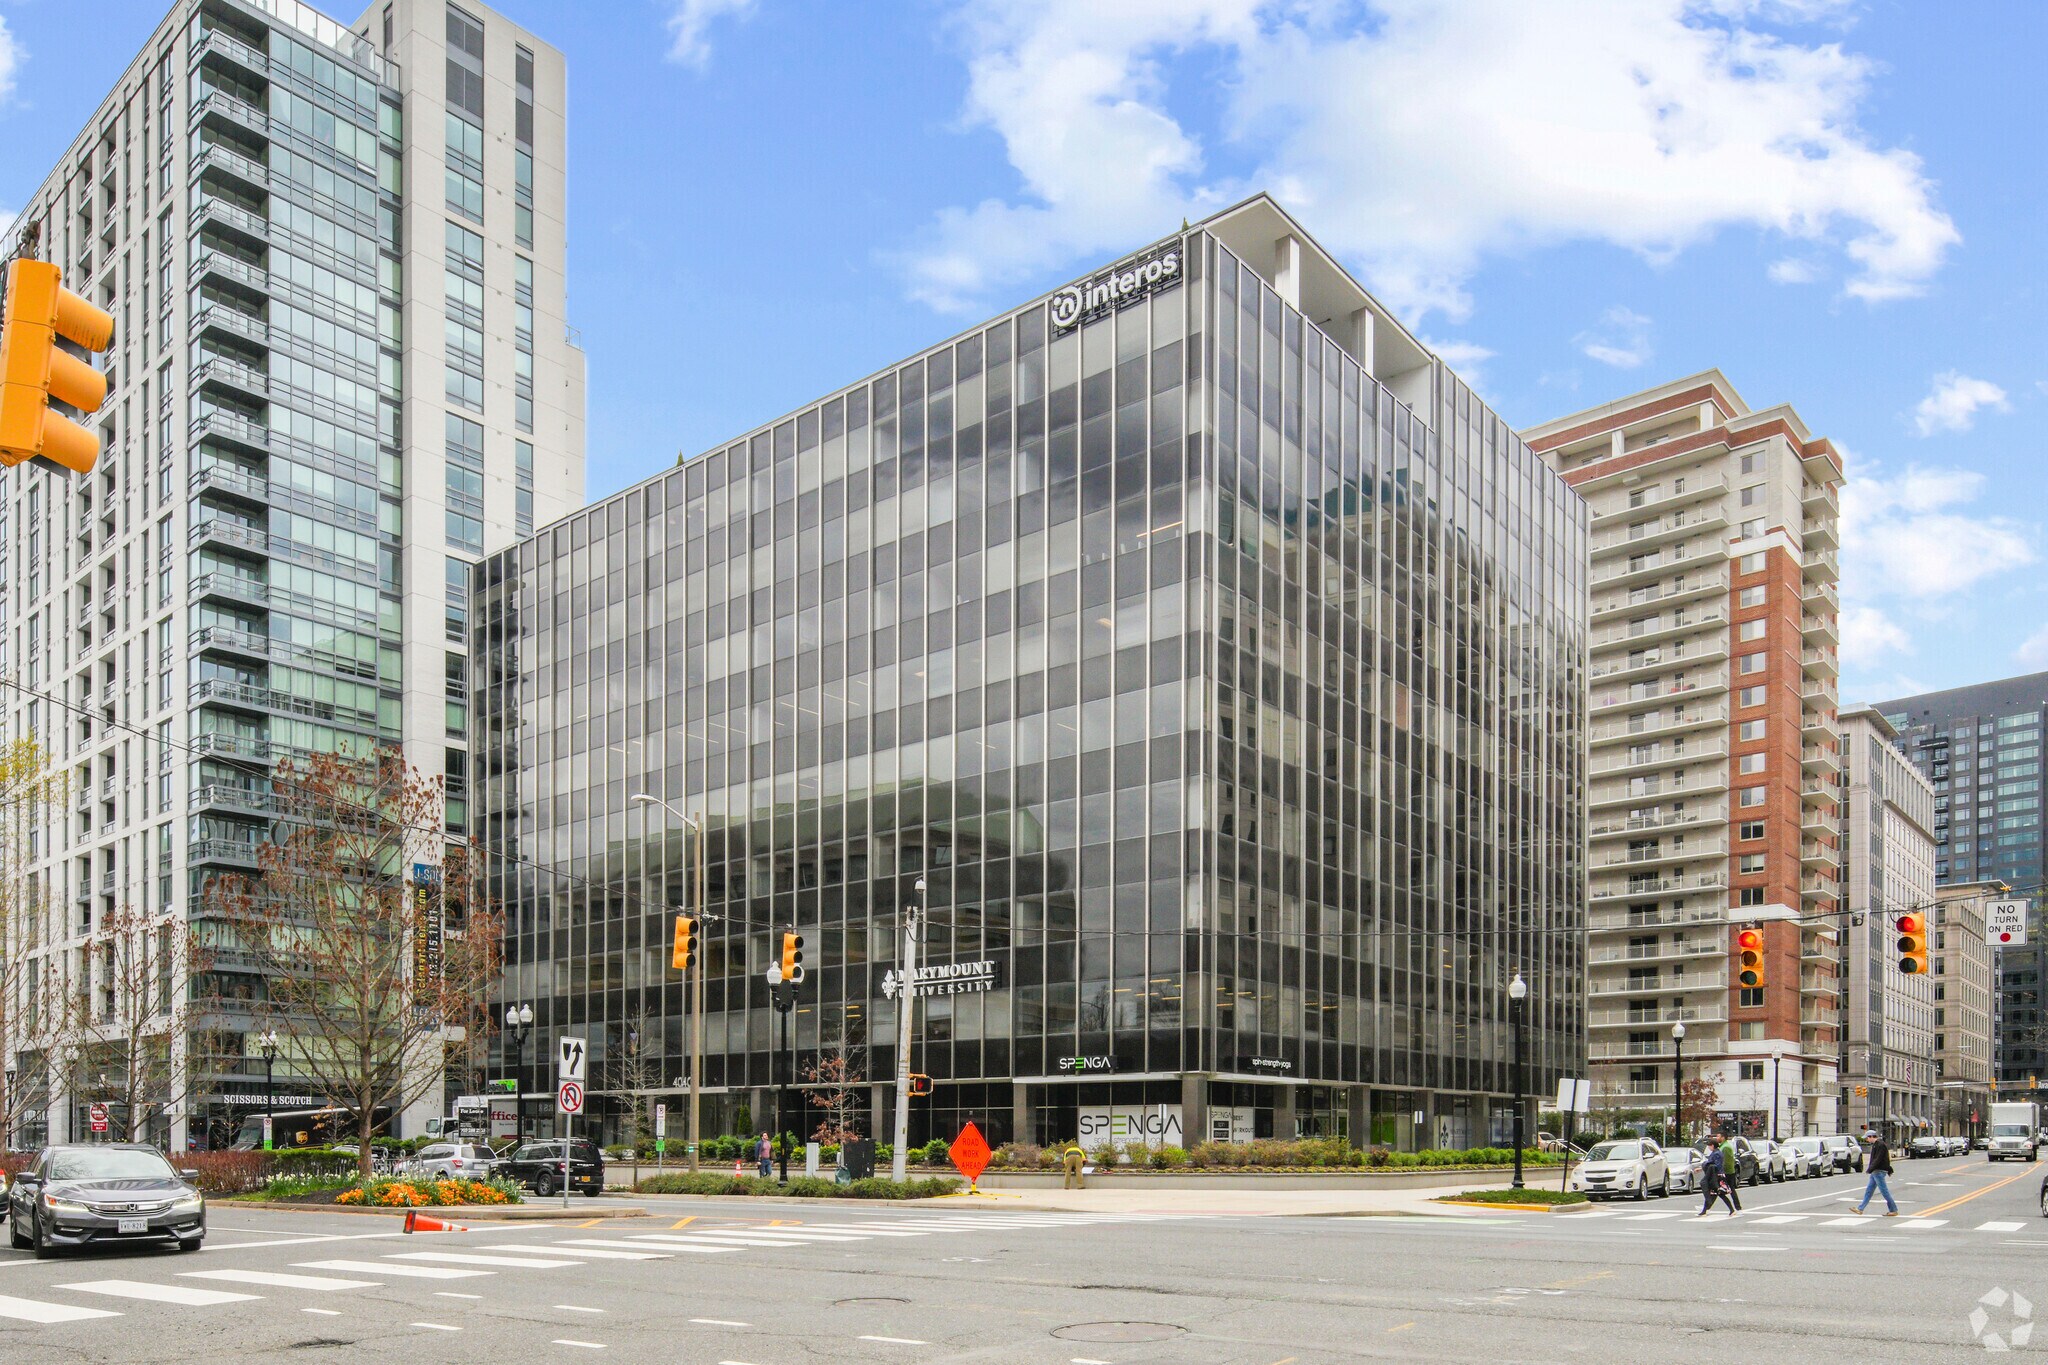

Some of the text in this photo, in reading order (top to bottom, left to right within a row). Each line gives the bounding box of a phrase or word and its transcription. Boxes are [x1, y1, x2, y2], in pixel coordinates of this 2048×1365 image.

[1085, 253, 1178, 311] interos
[1997, 904, 2015, 914] NO
[1995, 915, 2018, 924] TURN
[1988, 924, 2023, 933] ON RED
[1060, 1056, 1111, 1069] SPENGA
[223, 1095, 313, 1105] SCISSORS & SCOTCH
[1080, 1113, 1182, 1135] SPENGA
[962, 1138, 979, 1147] ROAD
[962, 1150, 979, 1158] WORK
[961, 1161, 982, 1170] AHEAD
